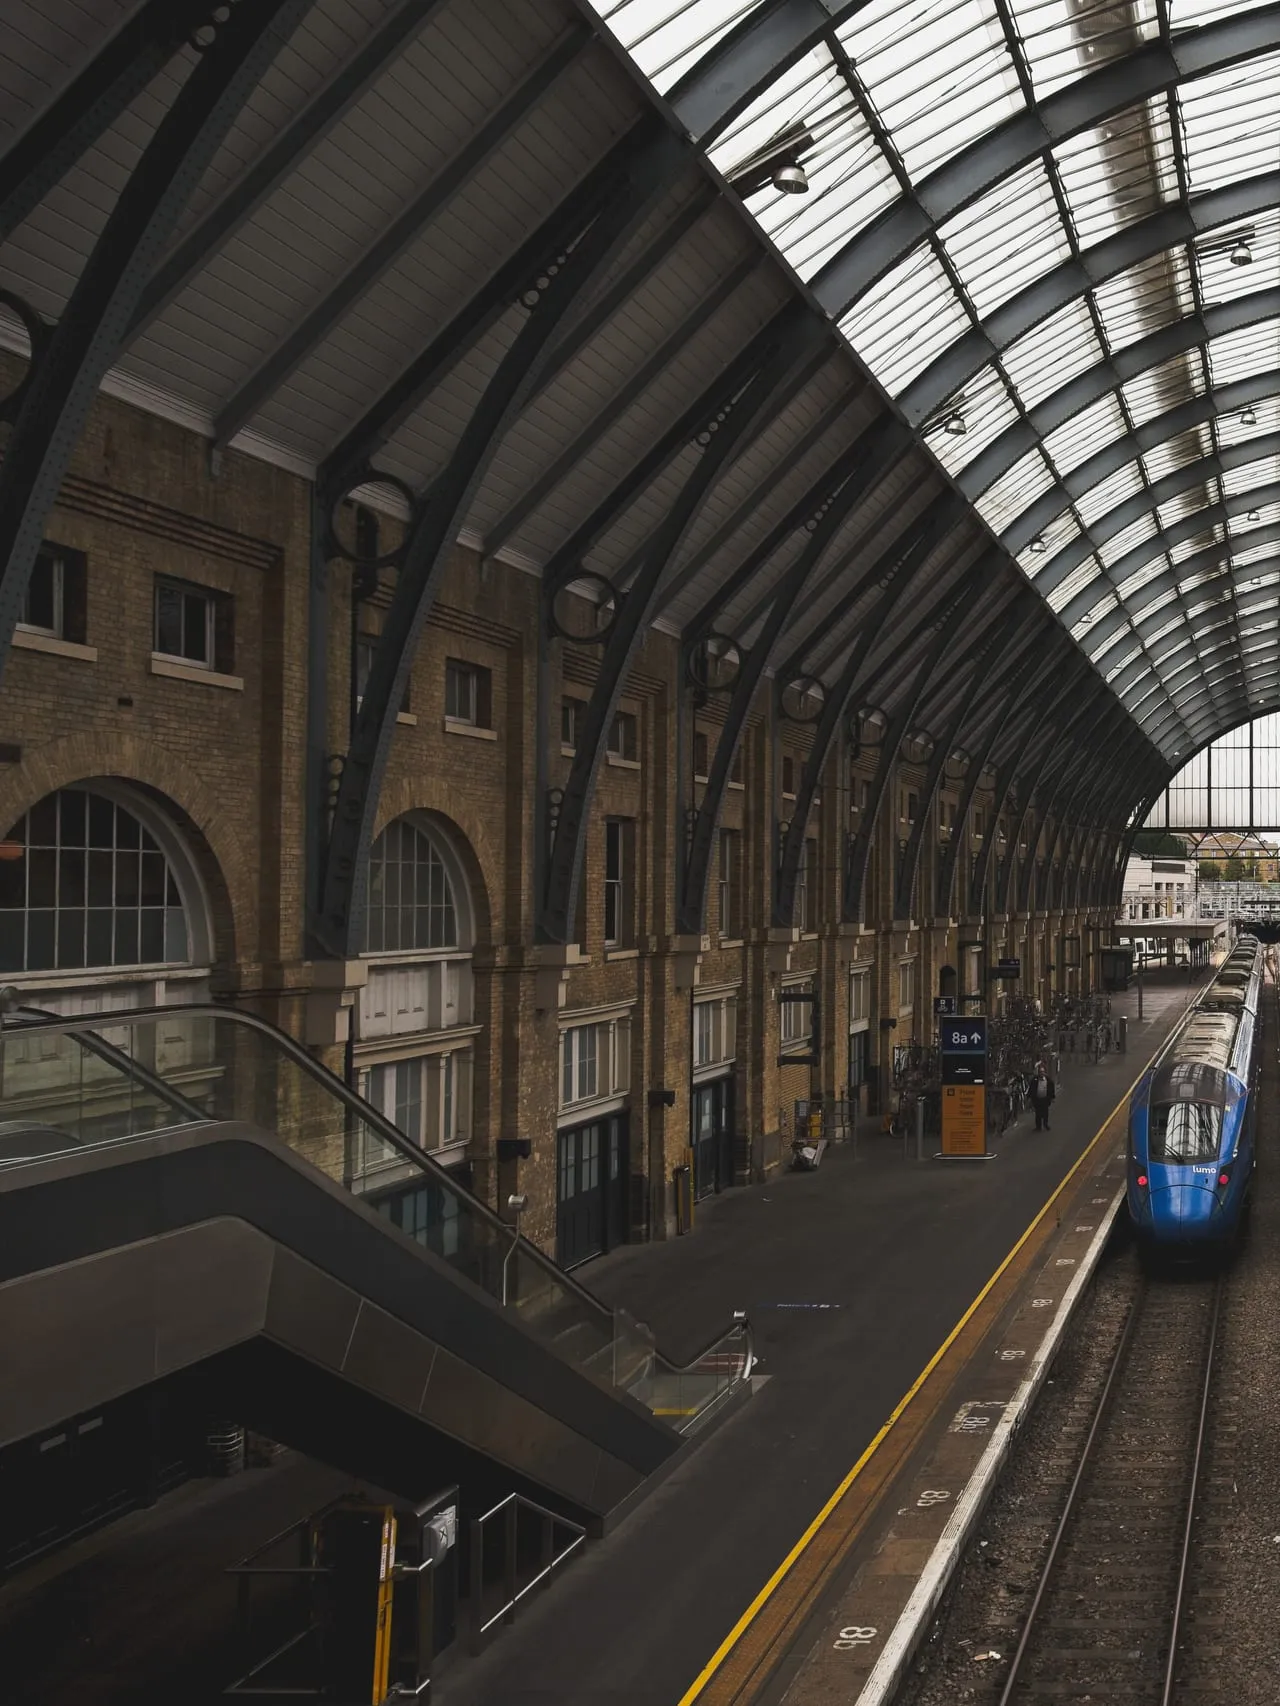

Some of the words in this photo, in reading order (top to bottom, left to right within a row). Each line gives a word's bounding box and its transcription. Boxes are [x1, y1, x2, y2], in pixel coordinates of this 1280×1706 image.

[952, 1032, 967, 1044] 8a
[1192, 1165, 1217, 1174] lumo
[833, 1626, 877, 1650] 8b
